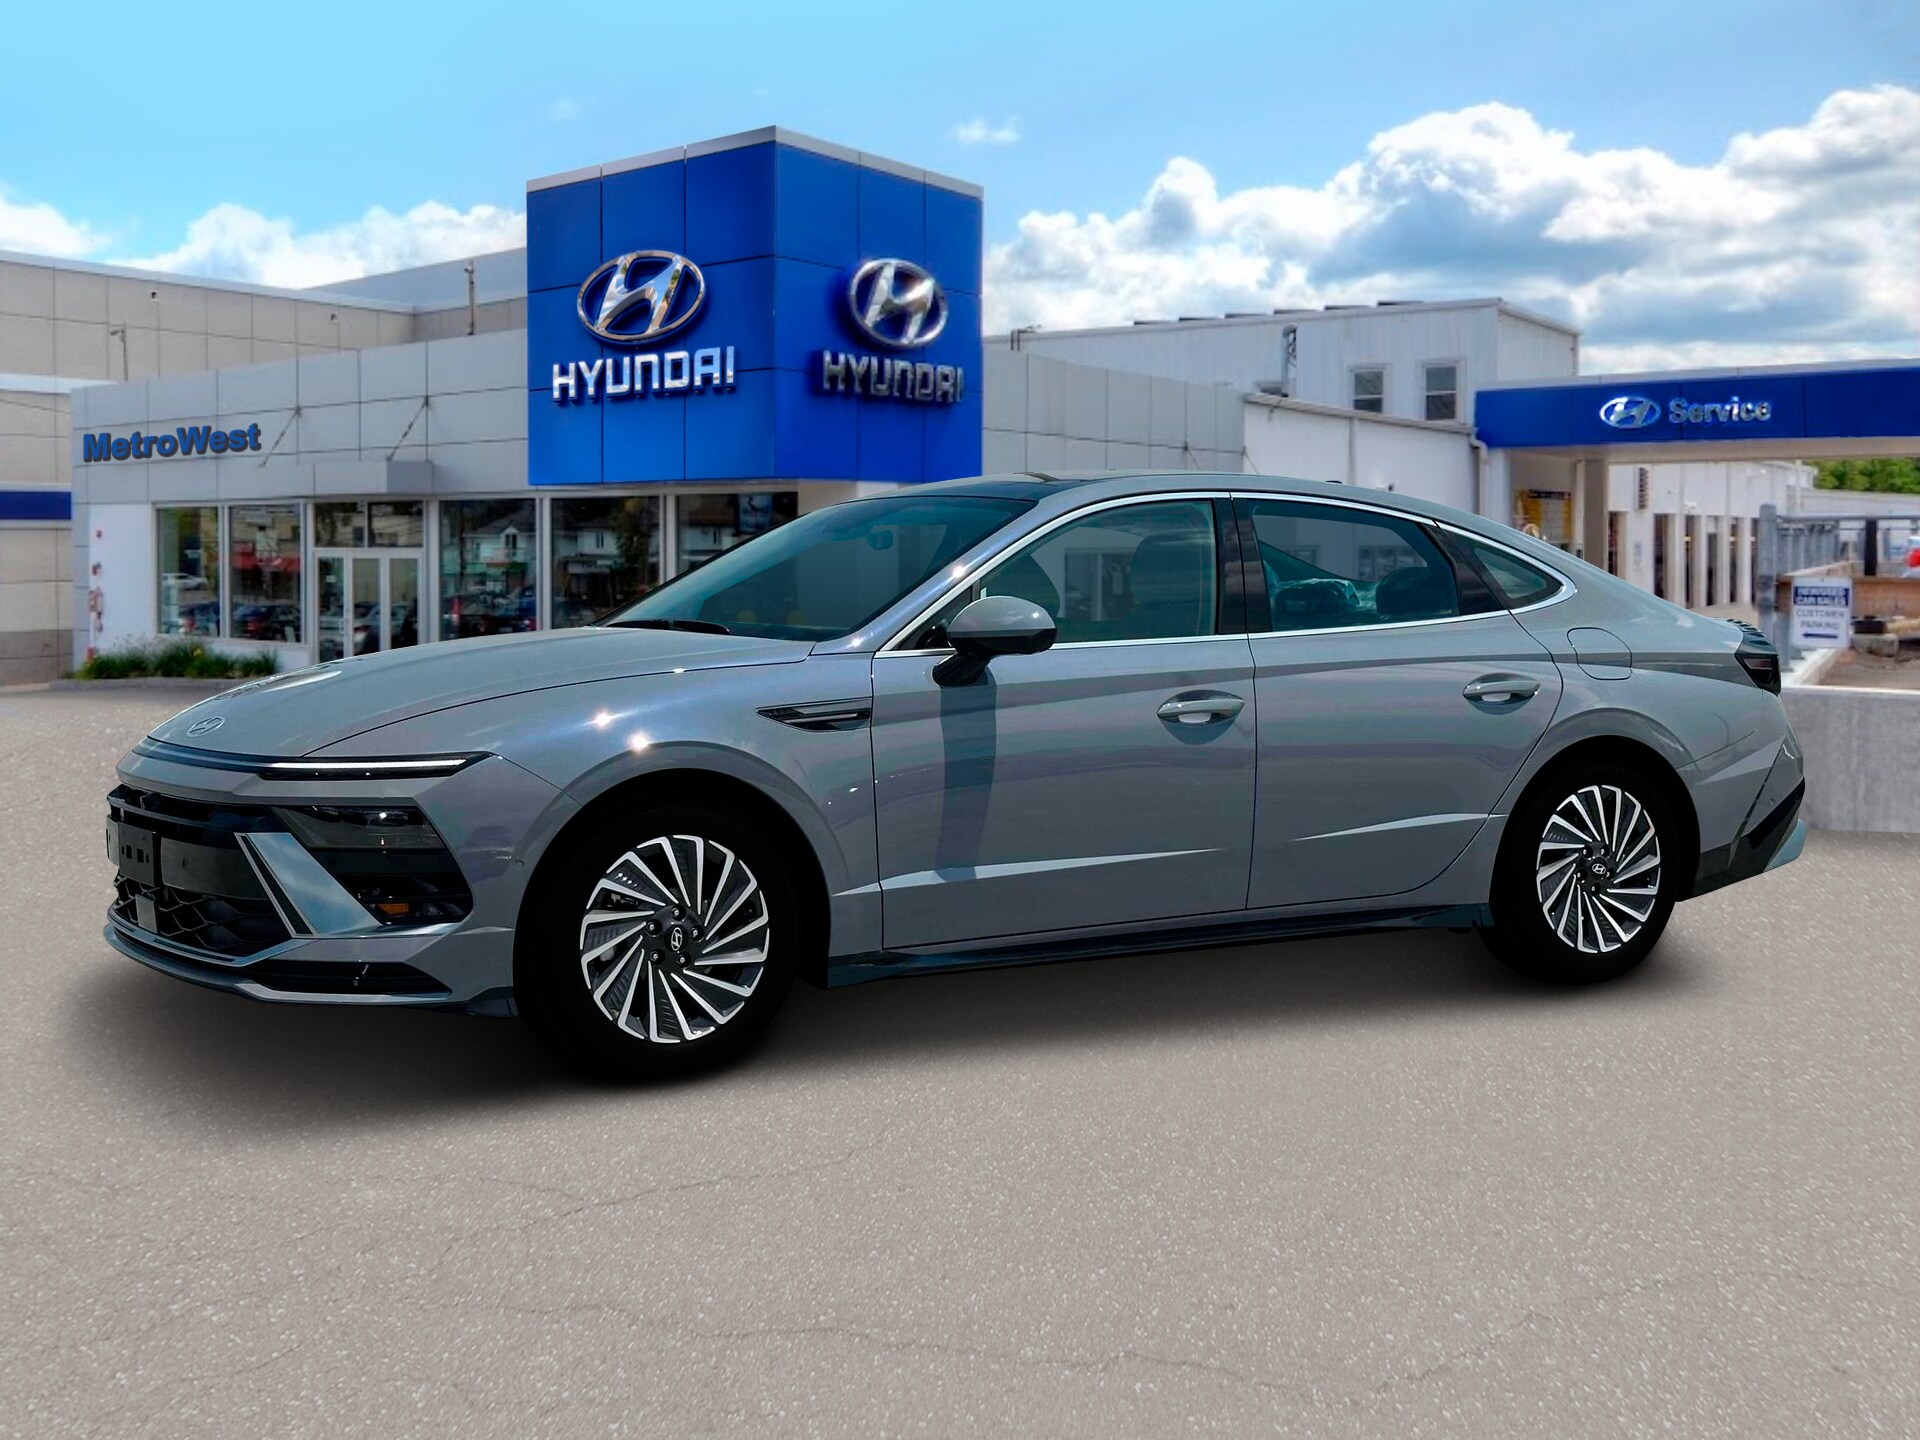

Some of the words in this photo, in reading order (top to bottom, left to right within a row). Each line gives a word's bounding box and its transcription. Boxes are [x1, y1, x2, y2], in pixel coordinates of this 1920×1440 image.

[553, 346, 735, 400] HYUNDAI
[823, 350, 964, 403] HYUNDAI
[1669, 396, 1772, 423] Service
[83, 423, 262, 463] MetroWest
[1796, 596, 1816, 606] CAR
[1796, 609, 1844, 618] CUSTOMER
[1801, 620, 1840, 630] PARKING
